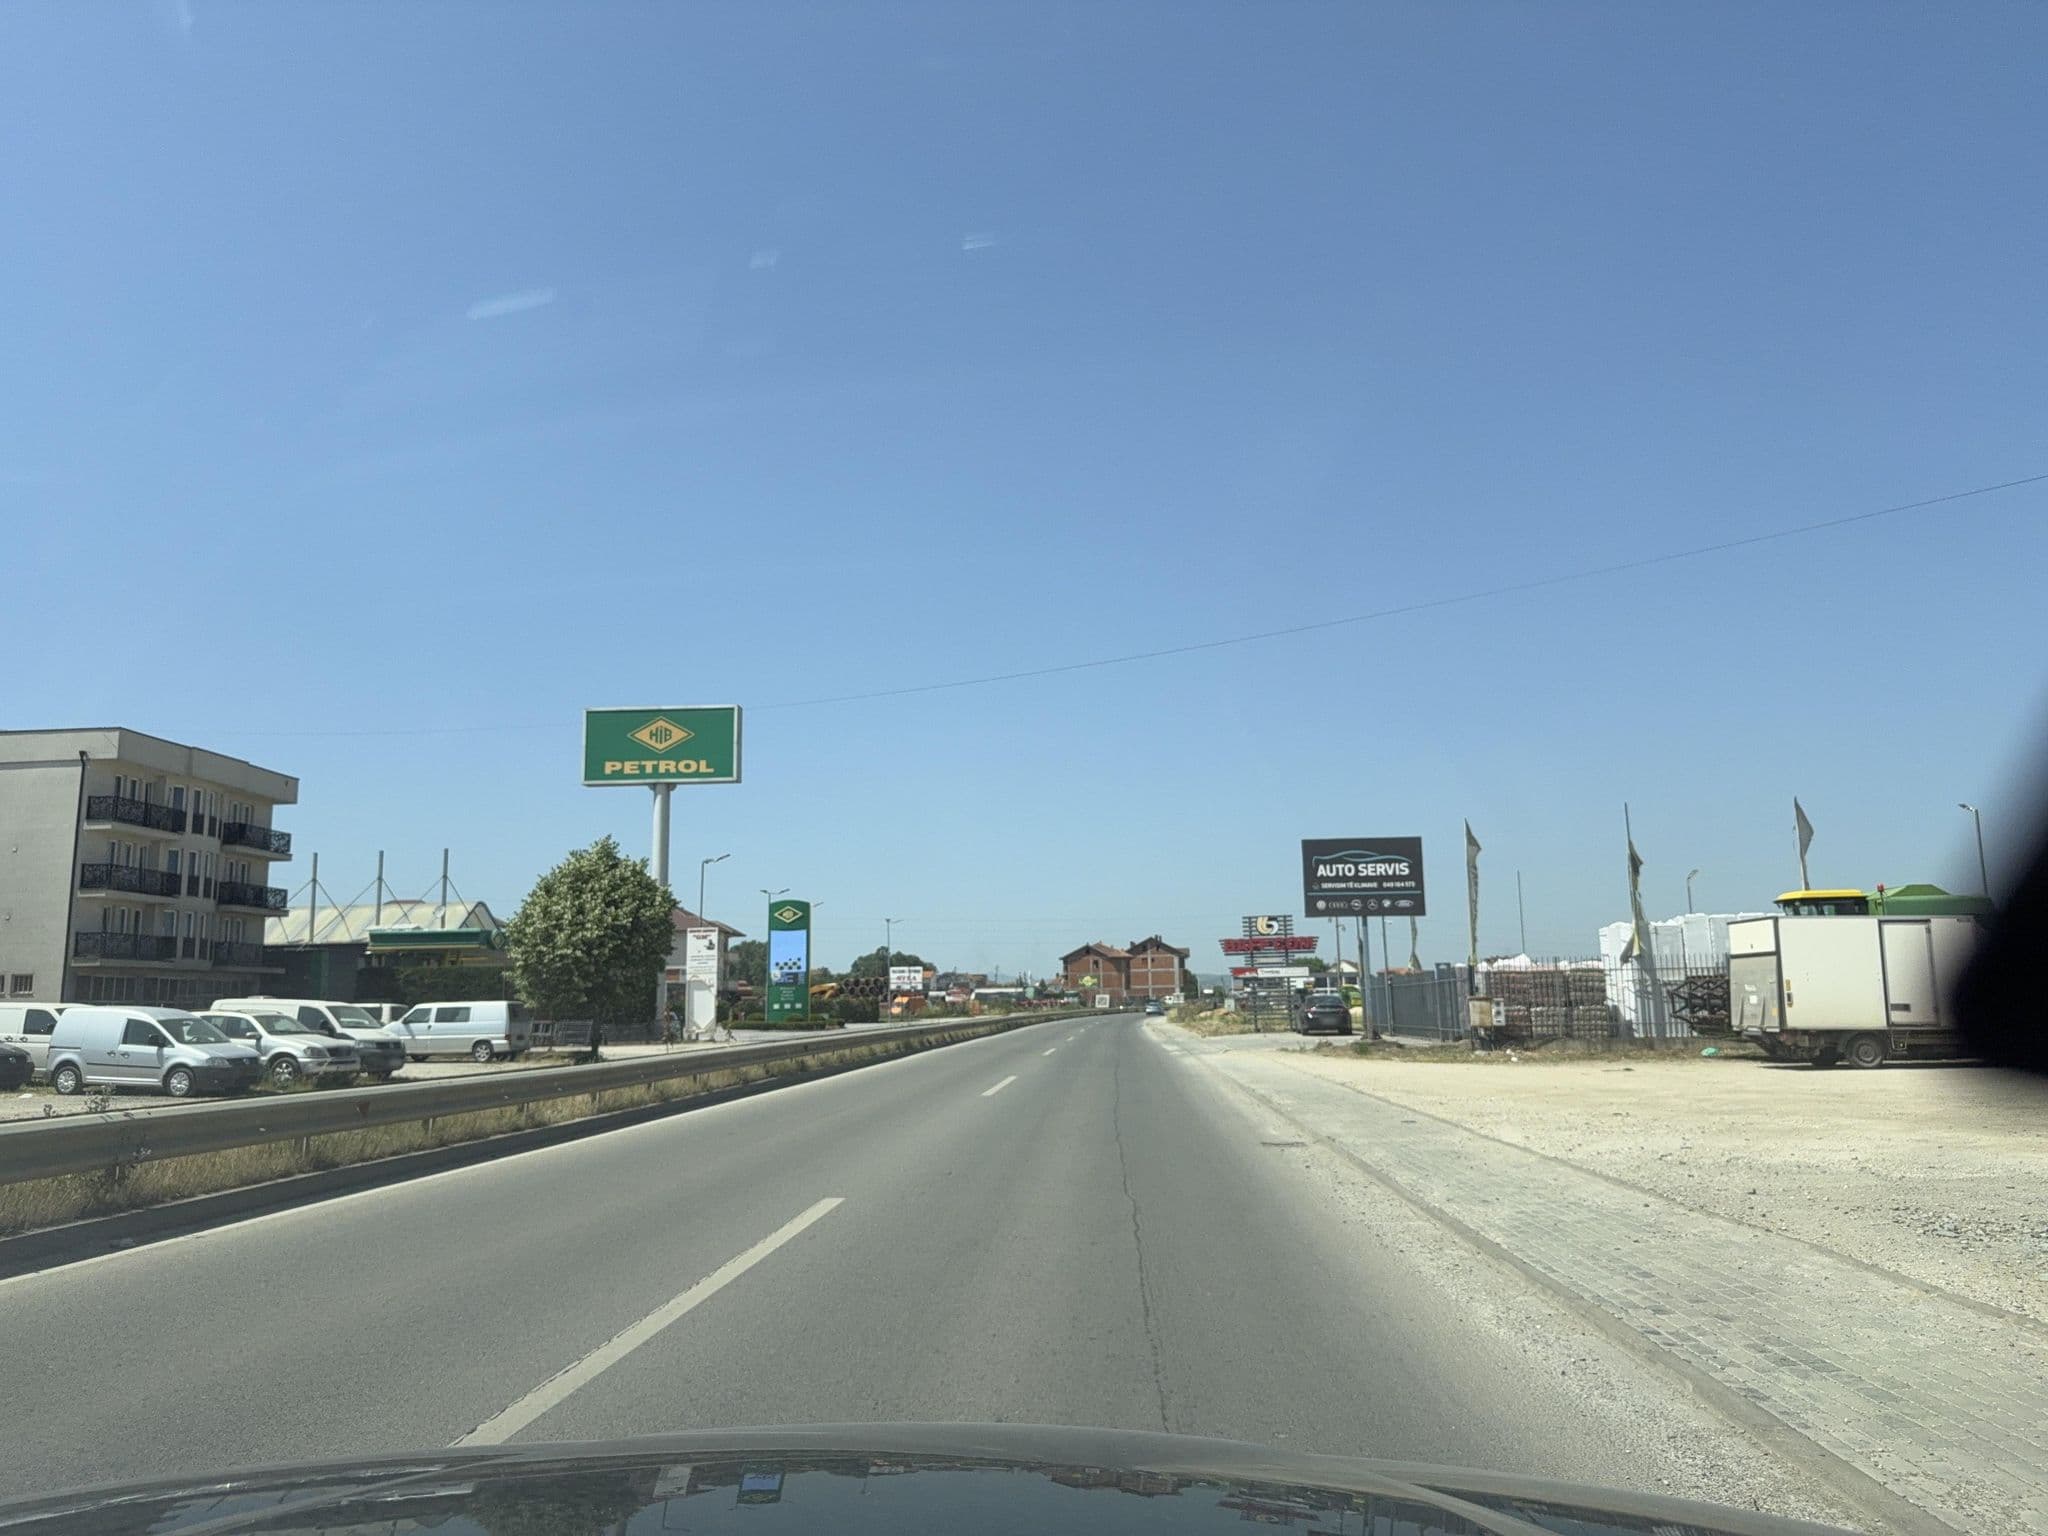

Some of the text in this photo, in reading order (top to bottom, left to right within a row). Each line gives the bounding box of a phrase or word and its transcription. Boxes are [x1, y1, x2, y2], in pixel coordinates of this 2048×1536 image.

[604, 759, 715, 775] PETROL
[1317, 862, 1410, 877] AUTO SERVIS
